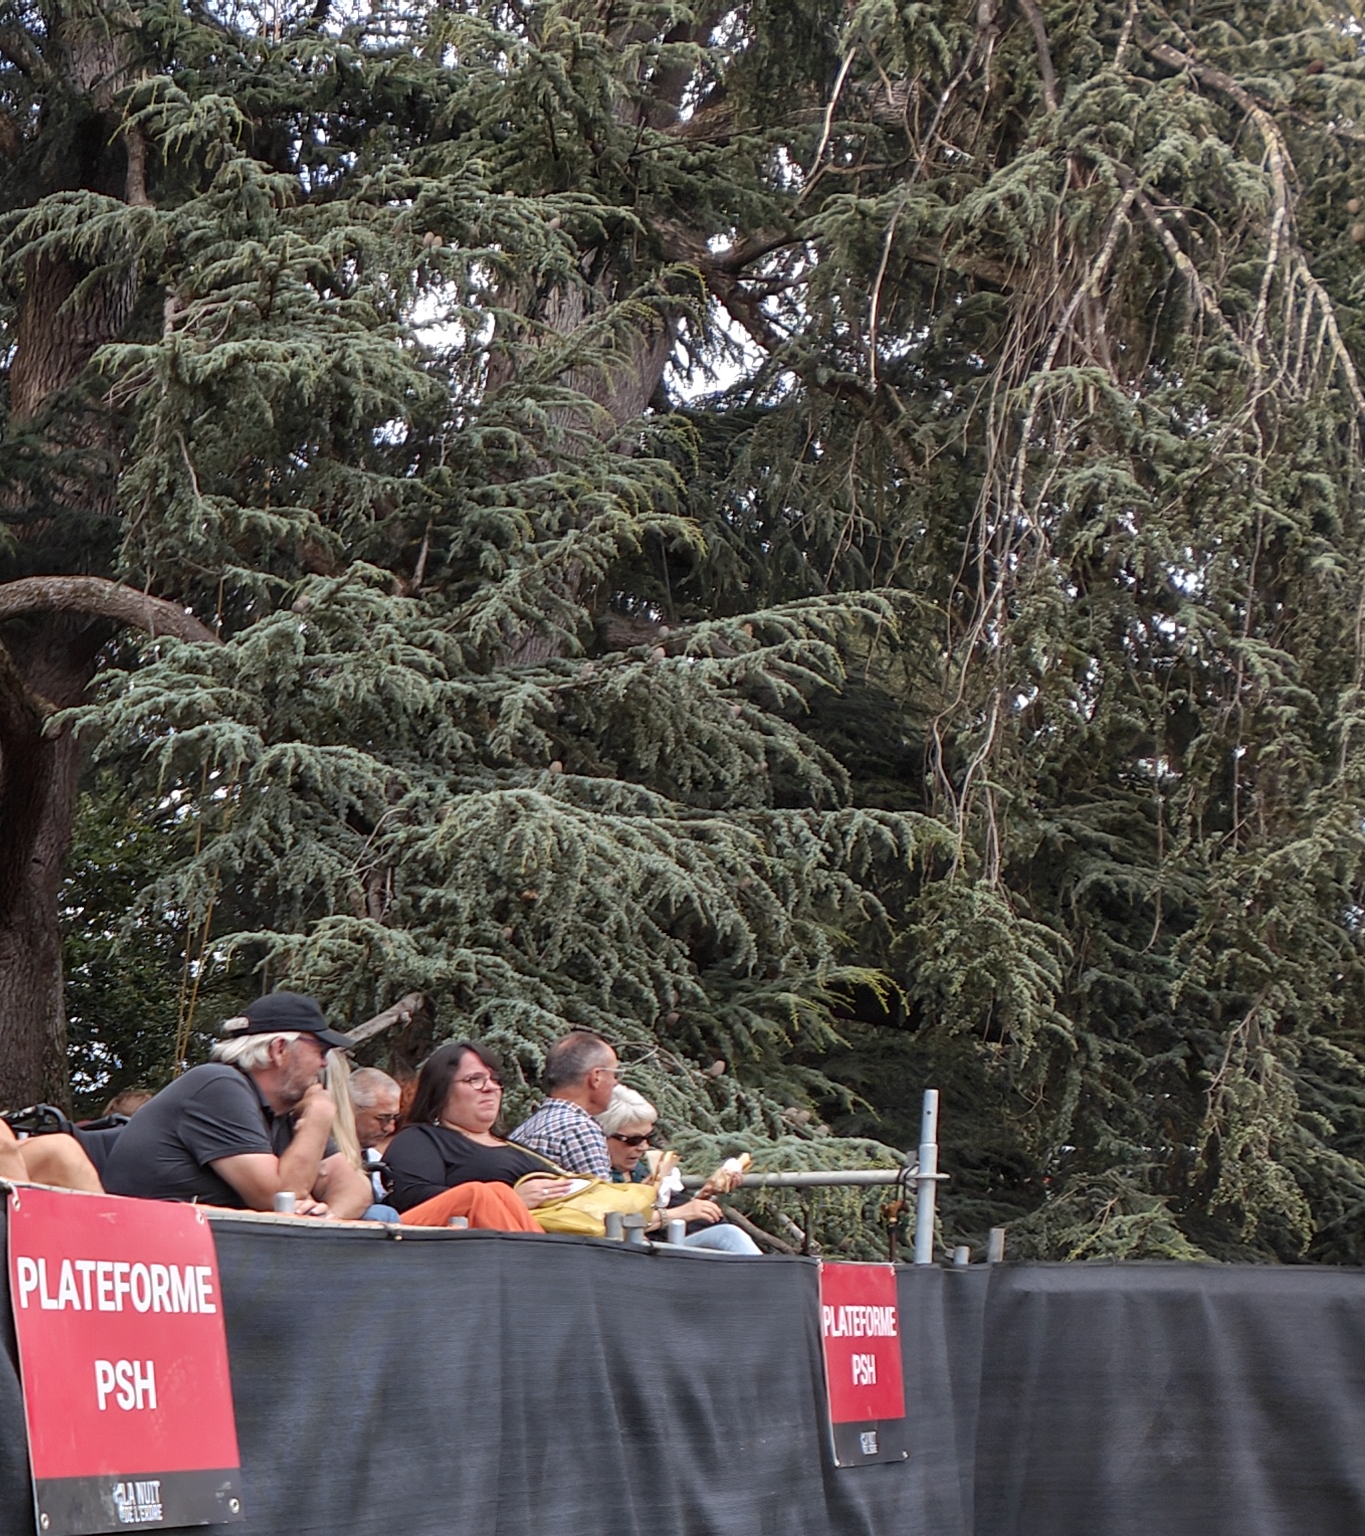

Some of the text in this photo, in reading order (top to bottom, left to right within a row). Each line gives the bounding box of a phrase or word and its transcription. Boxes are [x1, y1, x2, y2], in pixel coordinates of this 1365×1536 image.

[17, 1256, 217, 1315] PLATEFORME
[822, 1305, 898, 1338] PLATEFORME
[94, 1359, 157, 1411] PSH
[851, 1353, 877, 1386] PSH
